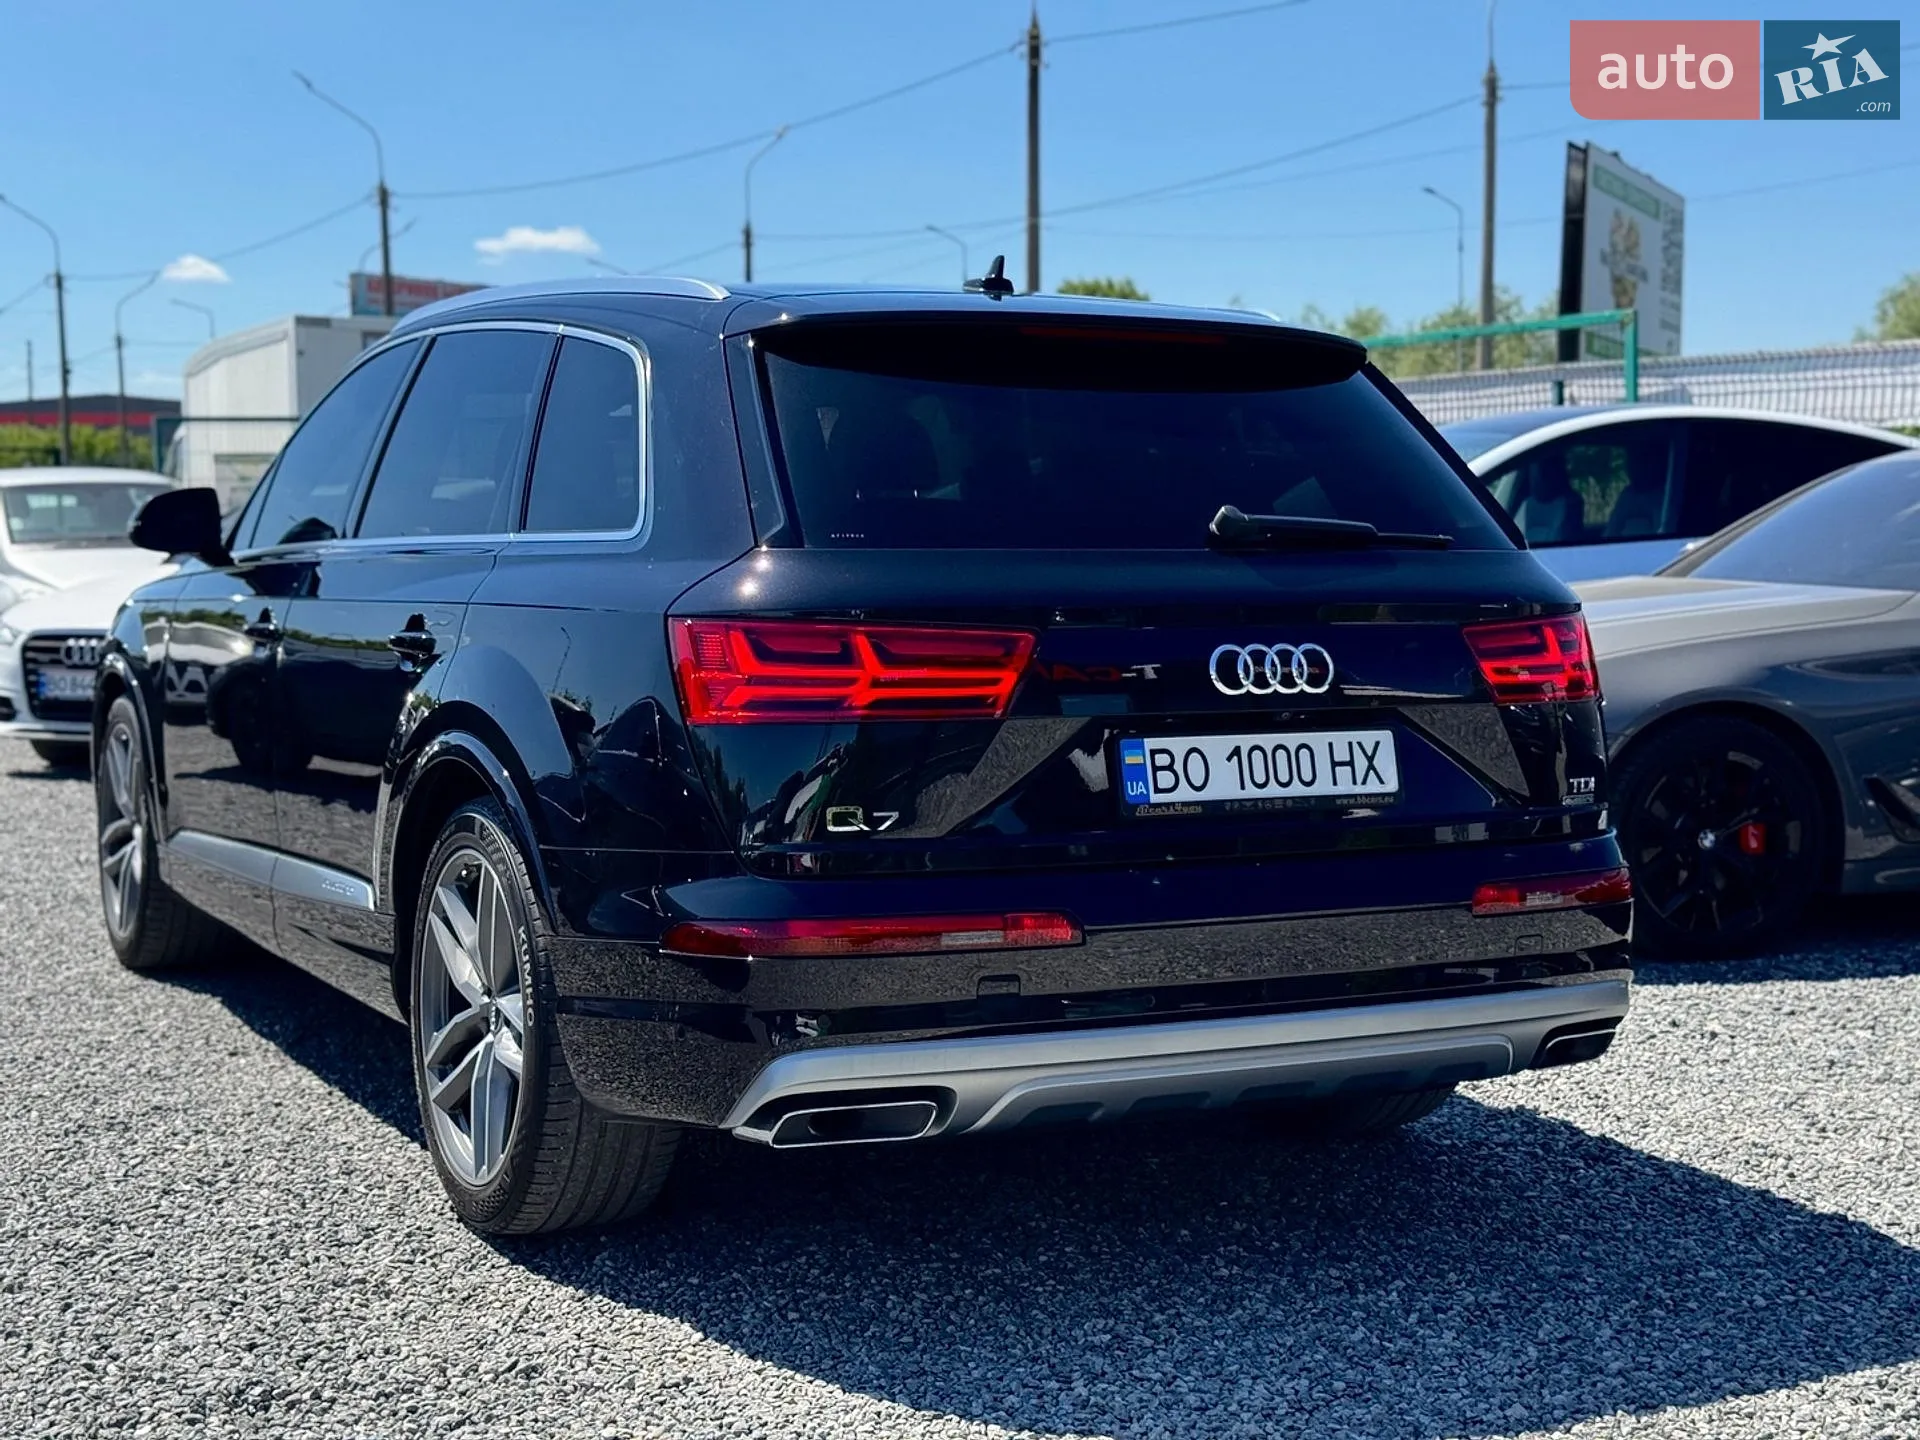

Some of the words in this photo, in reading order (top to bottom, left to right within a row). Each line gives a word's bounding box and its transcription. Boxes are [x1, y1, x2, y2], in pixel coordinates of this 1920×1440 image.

[1149, 746, 1210, 794] BO
[1226, 743, 1317, 791] 1000
[1328, 740, 1386, 786] HX
[1127, 780, 1147, 796] UA
[1569, 776, 1595, 793] TDI
[826, 805, 899, 832] Q7
[518, 925, 535, 1027] KUMHO
